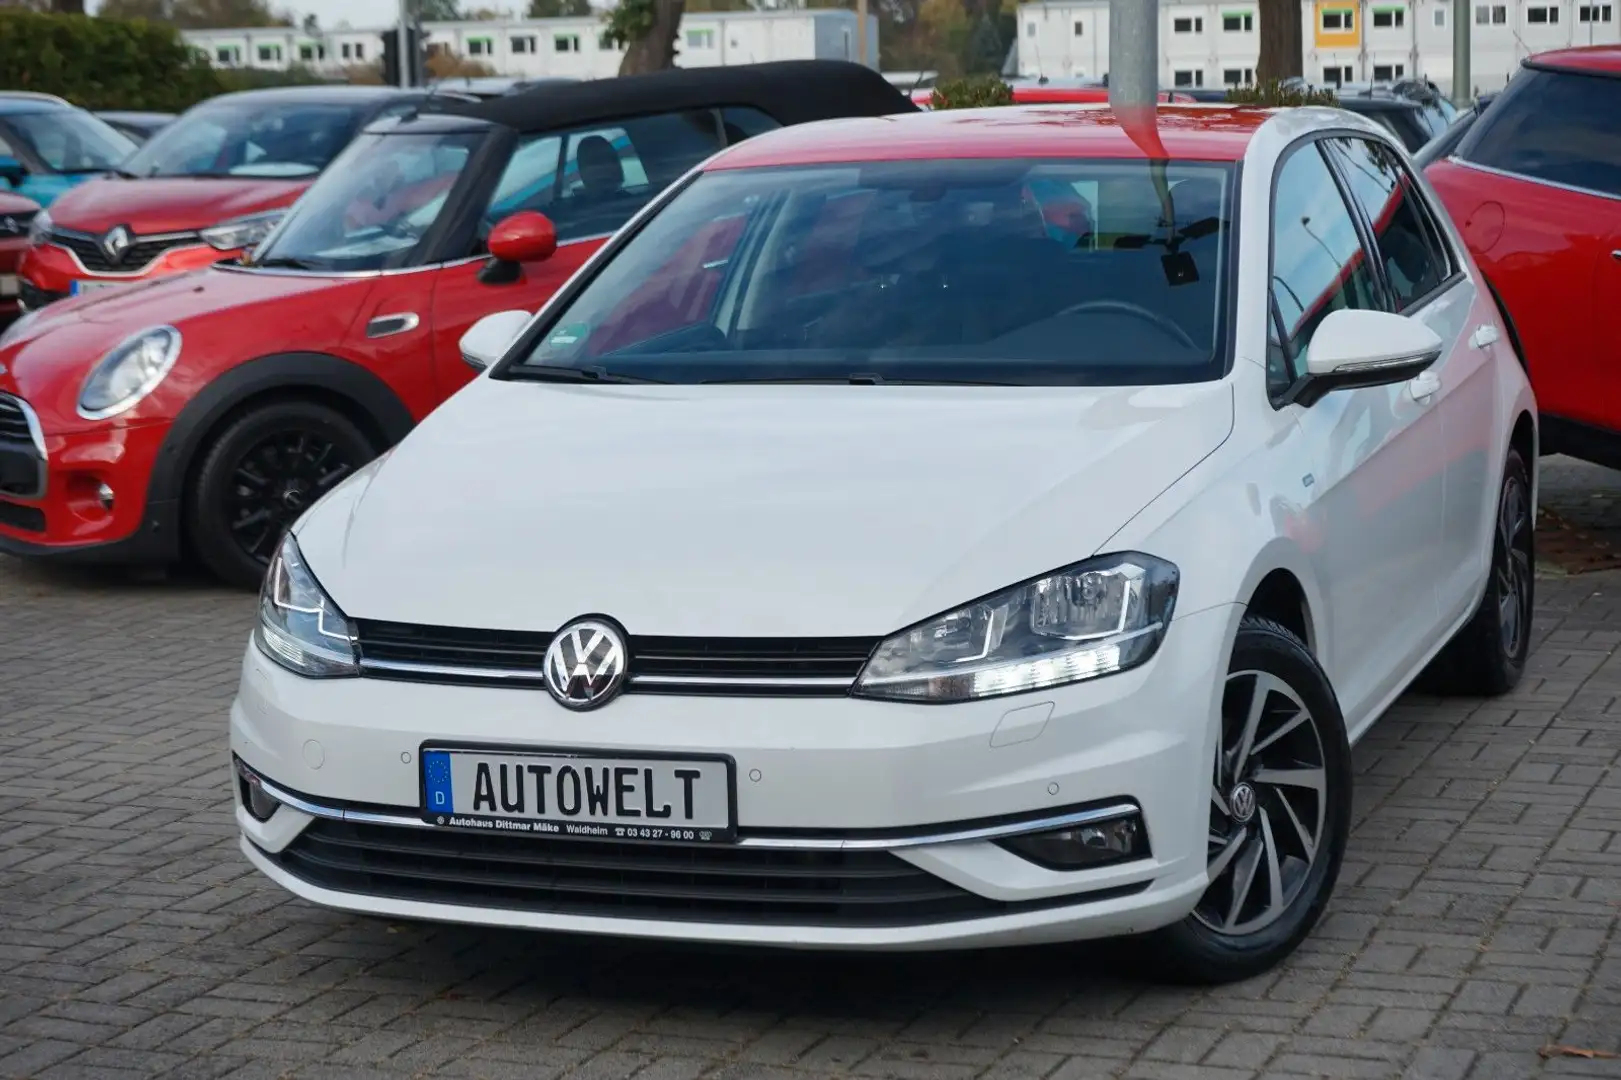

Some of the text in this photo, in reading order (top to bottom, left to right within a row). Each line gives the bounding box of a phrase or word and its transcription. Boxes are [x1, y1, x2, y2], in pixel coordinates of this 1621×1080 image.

[435, 791, 445, 805] D
[473, 762, 701, 820] AUTOWELT
[449, 816, 494, 828] Autohaus
[495, 819, 531, 831] Dittmar
[566, 824, 608, 836] Waldheim
[627, 828, 638, 837] 03
[640, 828, 651, 838] 43
[652, 829, 663, 838] 27
[683, 830, 694, 840] 00
